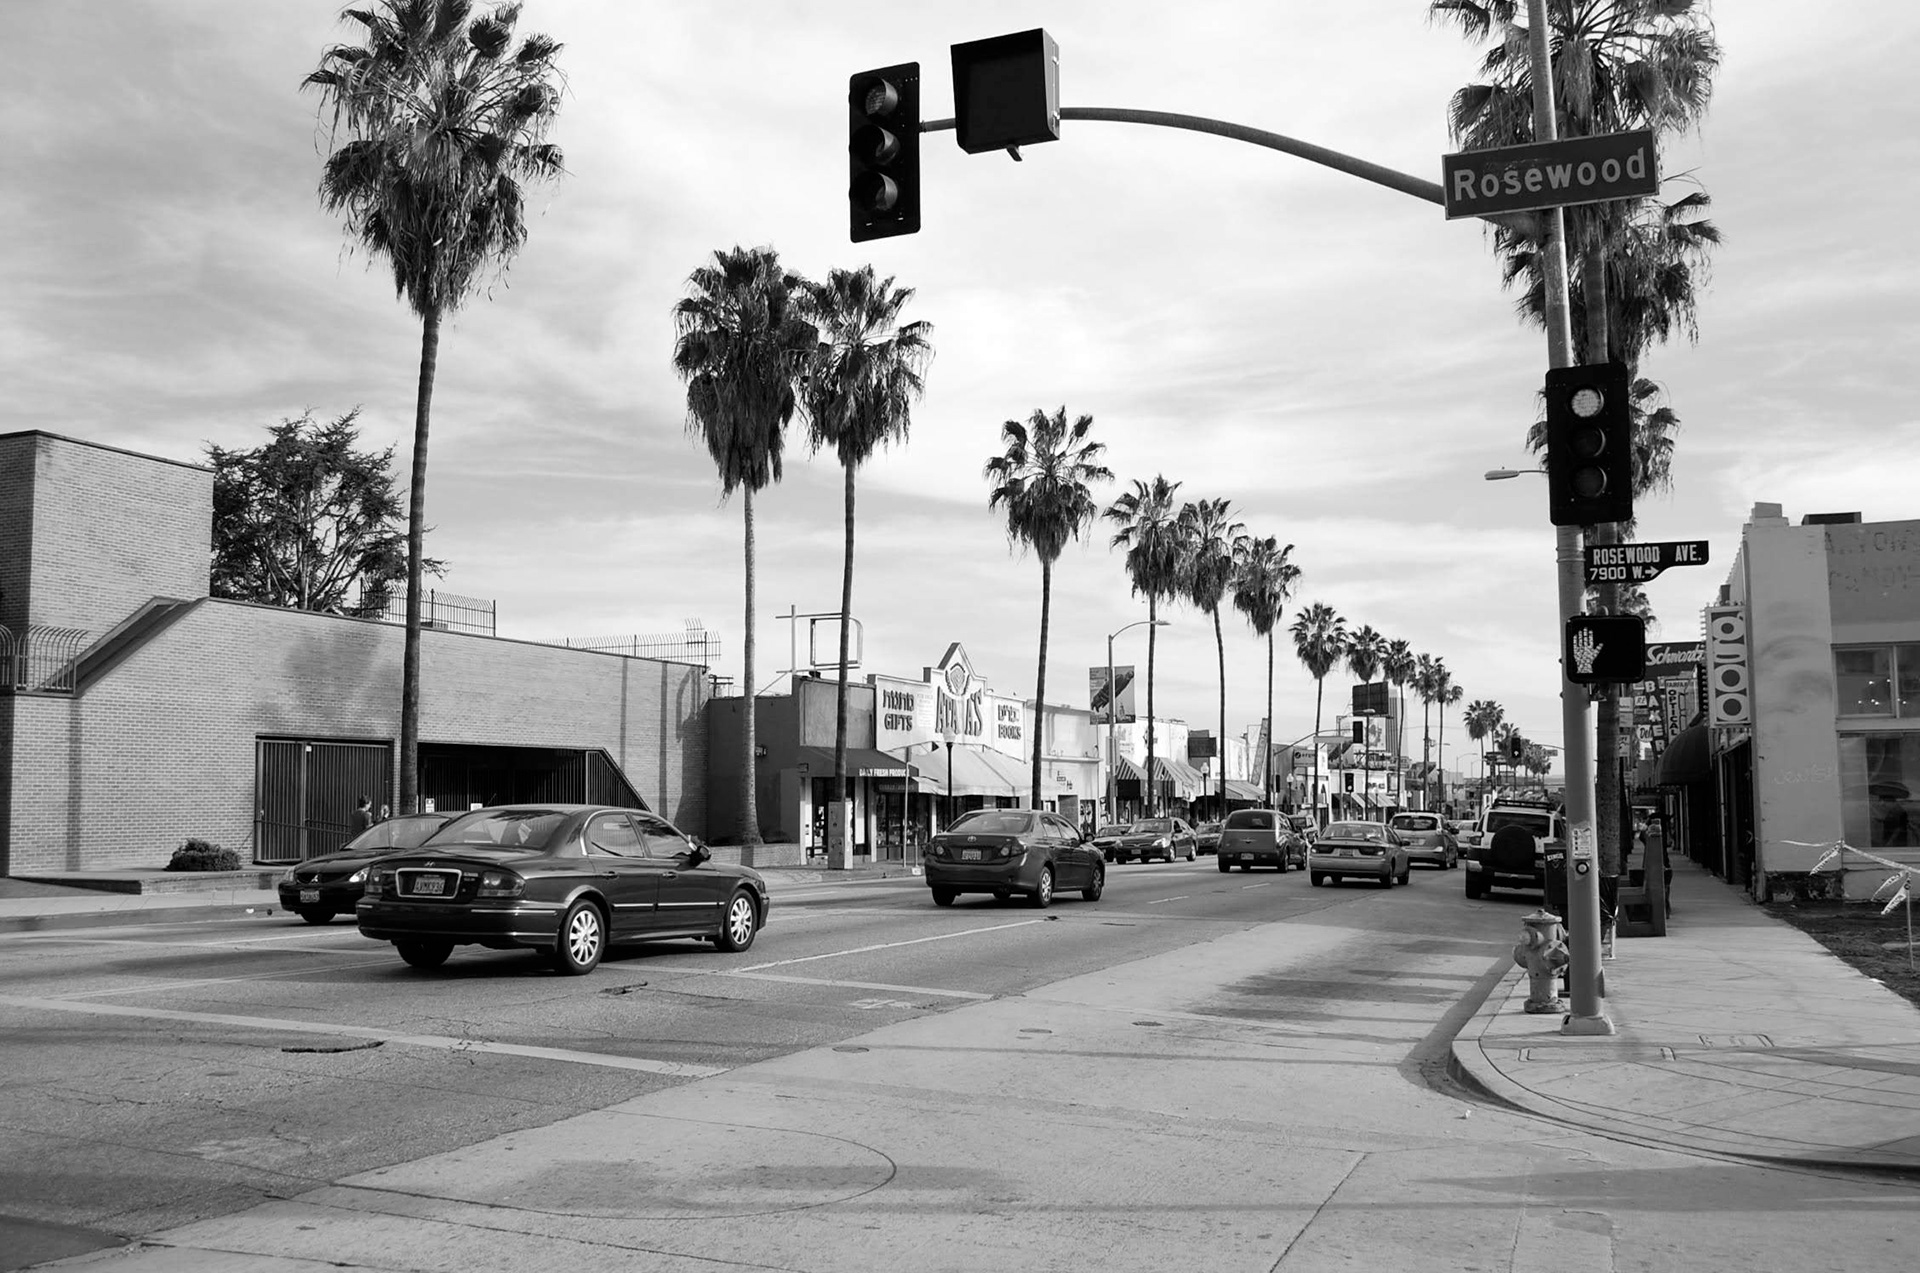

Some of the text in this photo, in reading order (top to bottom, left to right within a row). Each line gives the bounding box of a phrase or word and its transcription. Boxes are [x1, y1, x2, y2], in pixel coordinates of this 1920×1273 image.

[1453, 146, 1646, 202] Rosewood
[1593, 544, 1702, 566] ROSEWOOD AVE.
[1589, 565, 1645, 581] 7900 W.
[884, 713, 913, 731] GIFTS
[1645, 680, 1666, 757] BAKER
[1668, 689, 1679, 736] OPTICAL
[998, 723, 1022, 741] BOOKS
